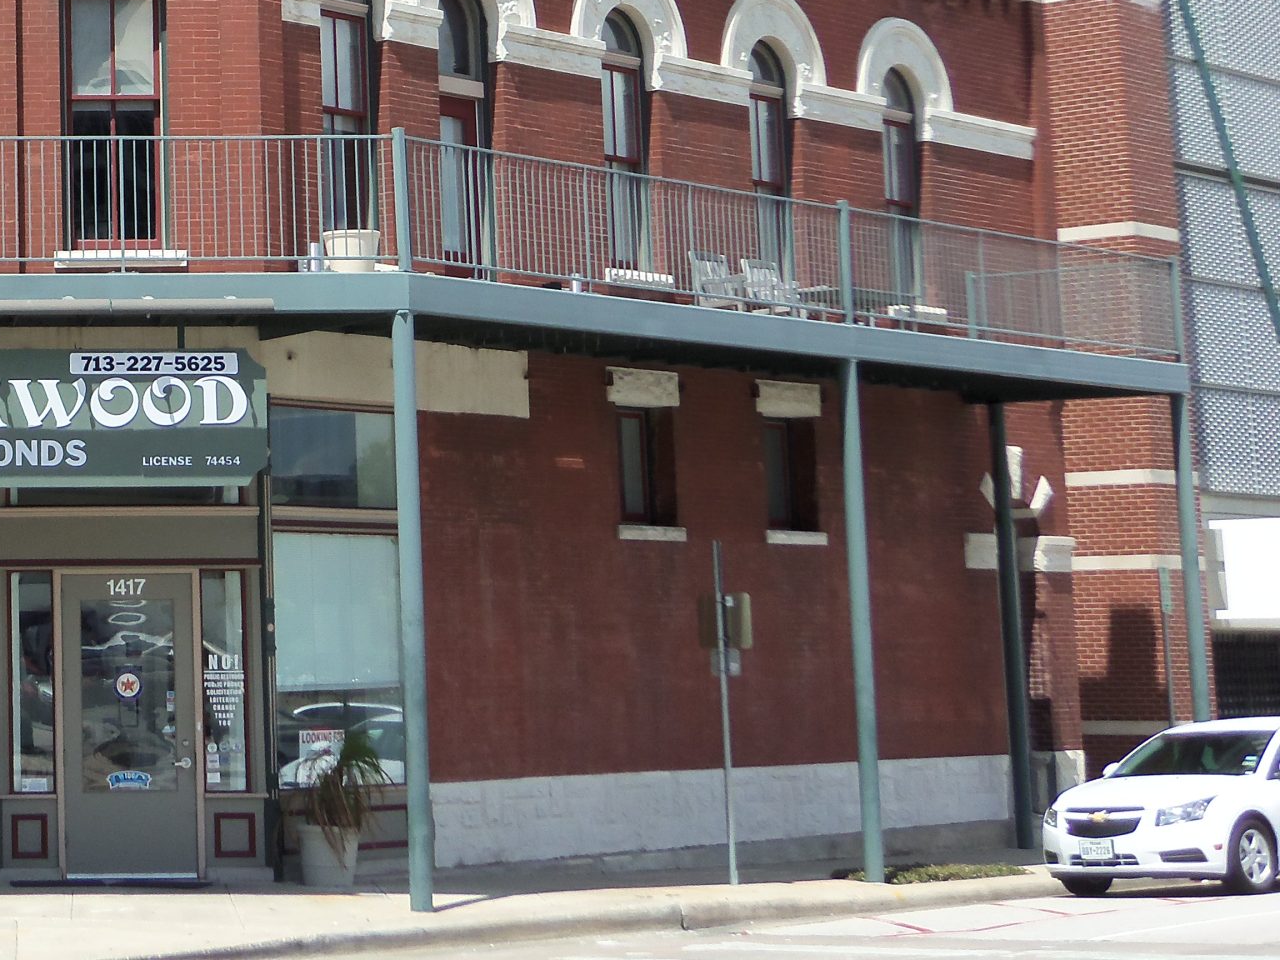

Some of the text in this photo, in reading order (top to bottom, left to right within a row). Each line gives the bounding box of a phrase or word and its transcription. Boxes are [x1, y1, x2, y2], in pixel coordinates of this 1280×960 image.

[80, 355, 226, 373] 713-227-5625
[142, 455, 241, 467] LICENSE 74454
[106, 578, 146, 596] 1417
[208, 654, 239, 670] NO!
